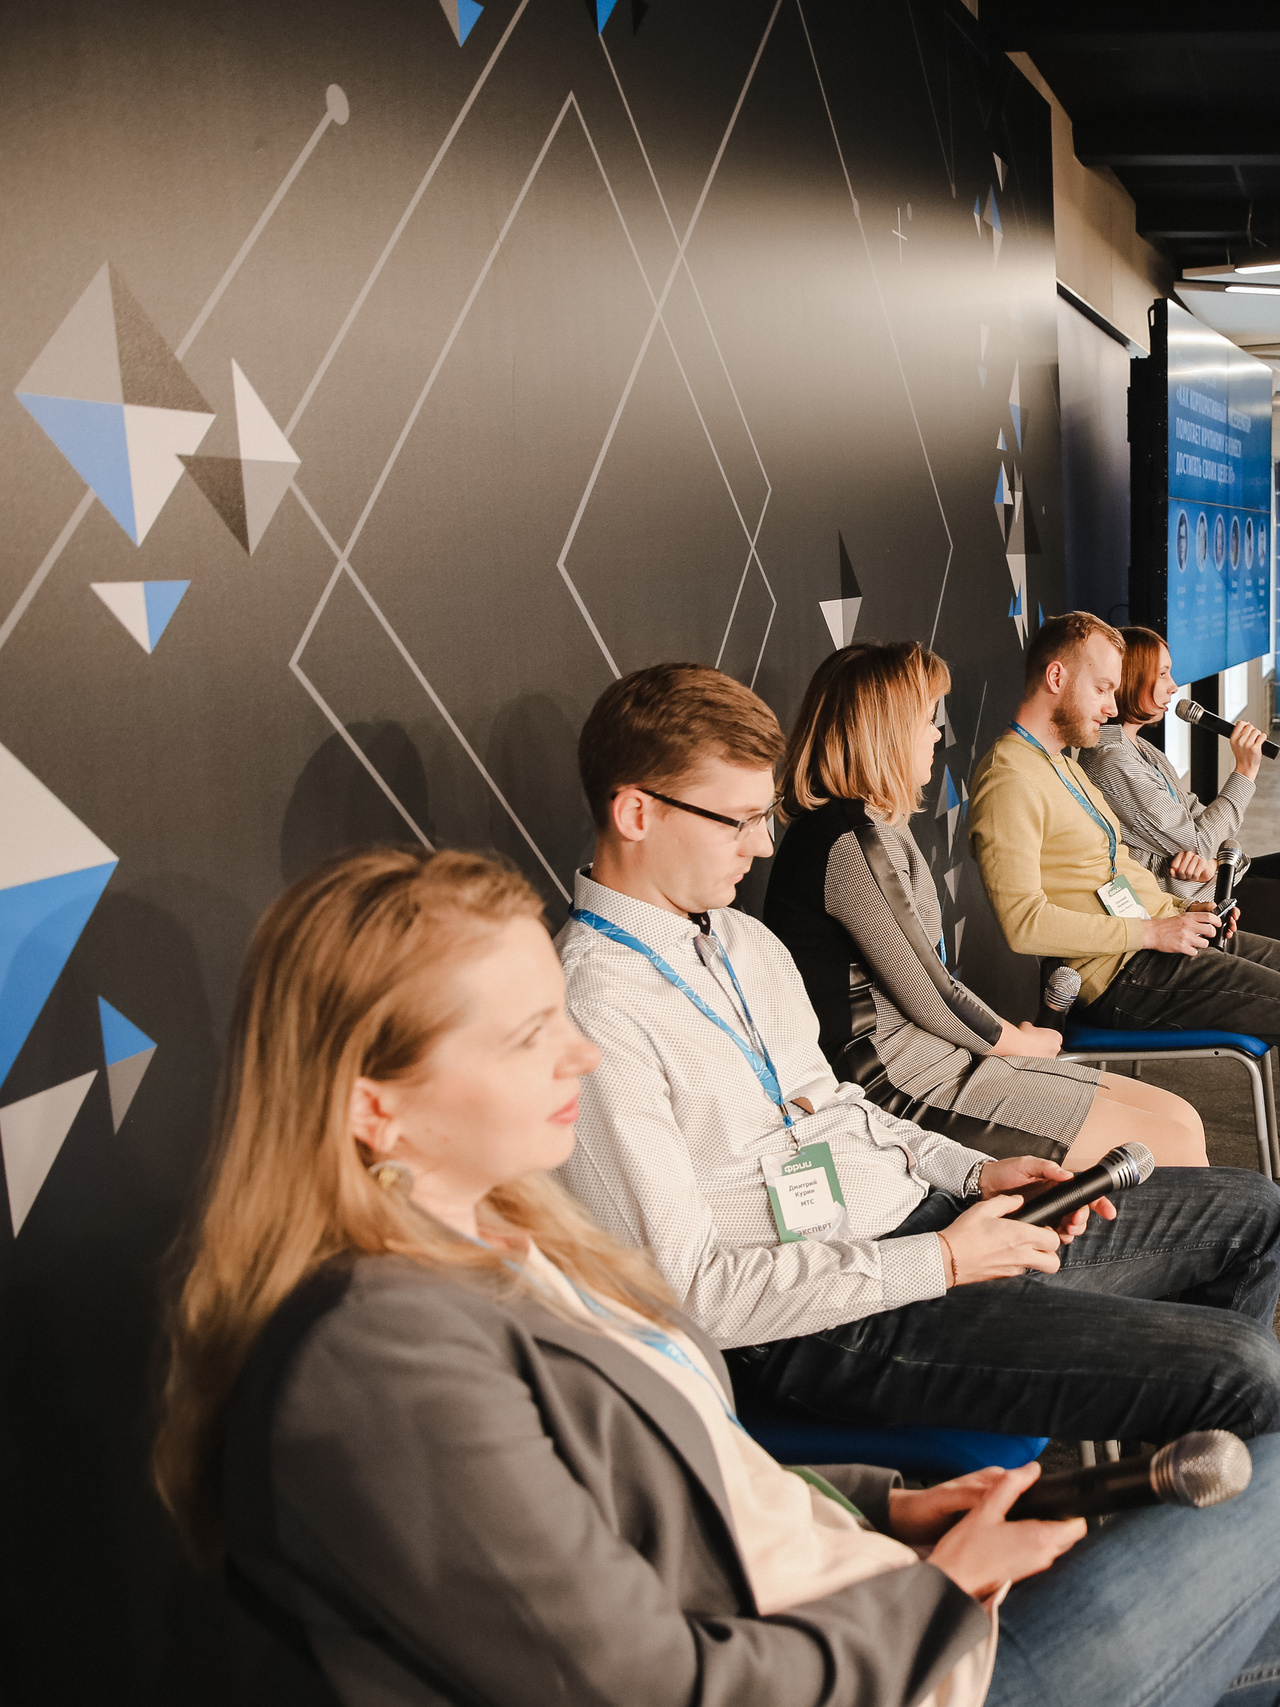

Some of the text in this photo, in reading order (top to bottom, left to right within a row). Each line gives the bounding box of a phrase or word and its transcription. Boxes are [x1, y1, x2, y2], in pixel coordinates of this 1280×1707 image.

[789, 1179, 818, 1192] Дмитрий
[795, 1189, 815, 1198] Курин
[800, 1199, 815, 1207] МТС
[797, 1222, 832, 1237] ЭКСПЕРТ
